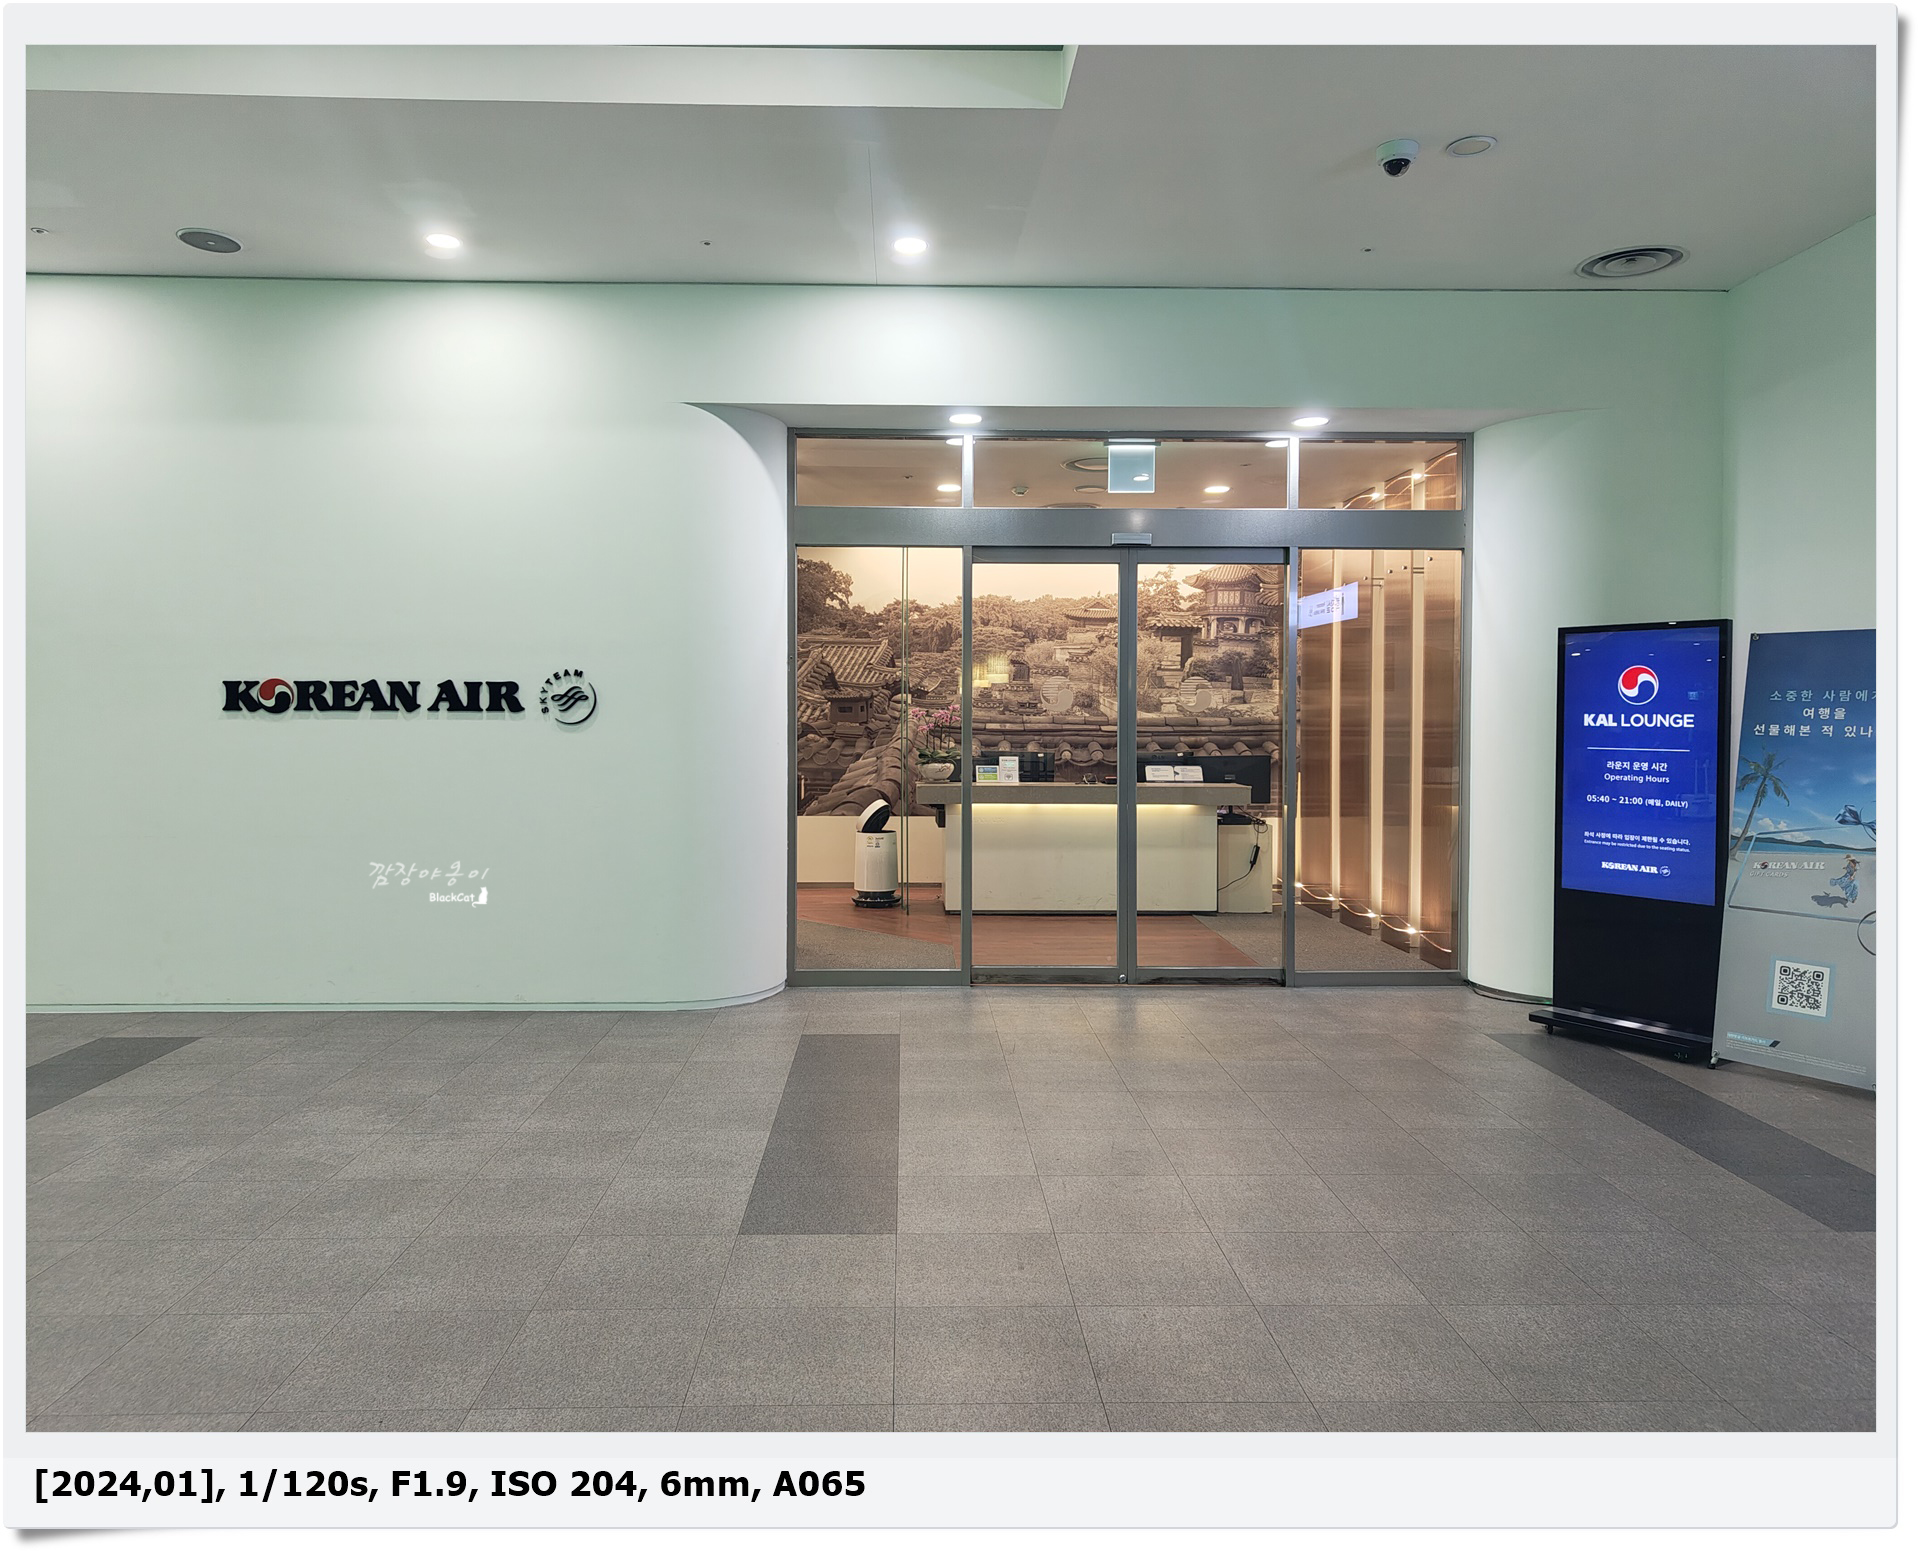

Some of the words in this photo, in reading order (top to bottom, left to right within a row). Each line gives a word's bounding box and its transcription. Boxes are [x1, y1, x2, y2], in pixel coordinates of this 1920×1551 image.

[222, 677, 421, 713] KOREAN
[427, 679, 525, 713] AIR
[539, 669, 584, 714] SKYTEAM
[1770, 689, 1813, 702] 소중한
[1802, 707, 1846, 720] 여행을
[1583, 713, 1618, 727] KAL
[1621, 713, 1695, 728] LOUNGE
[1753, 724, 1811, 737] 선물해본
[1821, 725, 1834, 738] 적
[1844, 725, 1874, 738] 있나
[1606, 761, 1630, 770] 라운지
[1632, 762, 1649, 771] 운영
[1651, 762, 1668, 772] 시간
[1604, 773, 1644, 783] Operating
[1645, 774, 1670, 783] Hours
[1586, 794, 1610, 803] 05:40
[1619, 796, 1643, 805] 21:00
[1665, 799, 1689, 809] DAILY)
[1601, 861, 1639, 872] KOREAN
[1639, 865, 1659, 874] AIR
[1752, 861, 1798, 870] KOREAN
[1800, 861, 1826, 870] AIR
